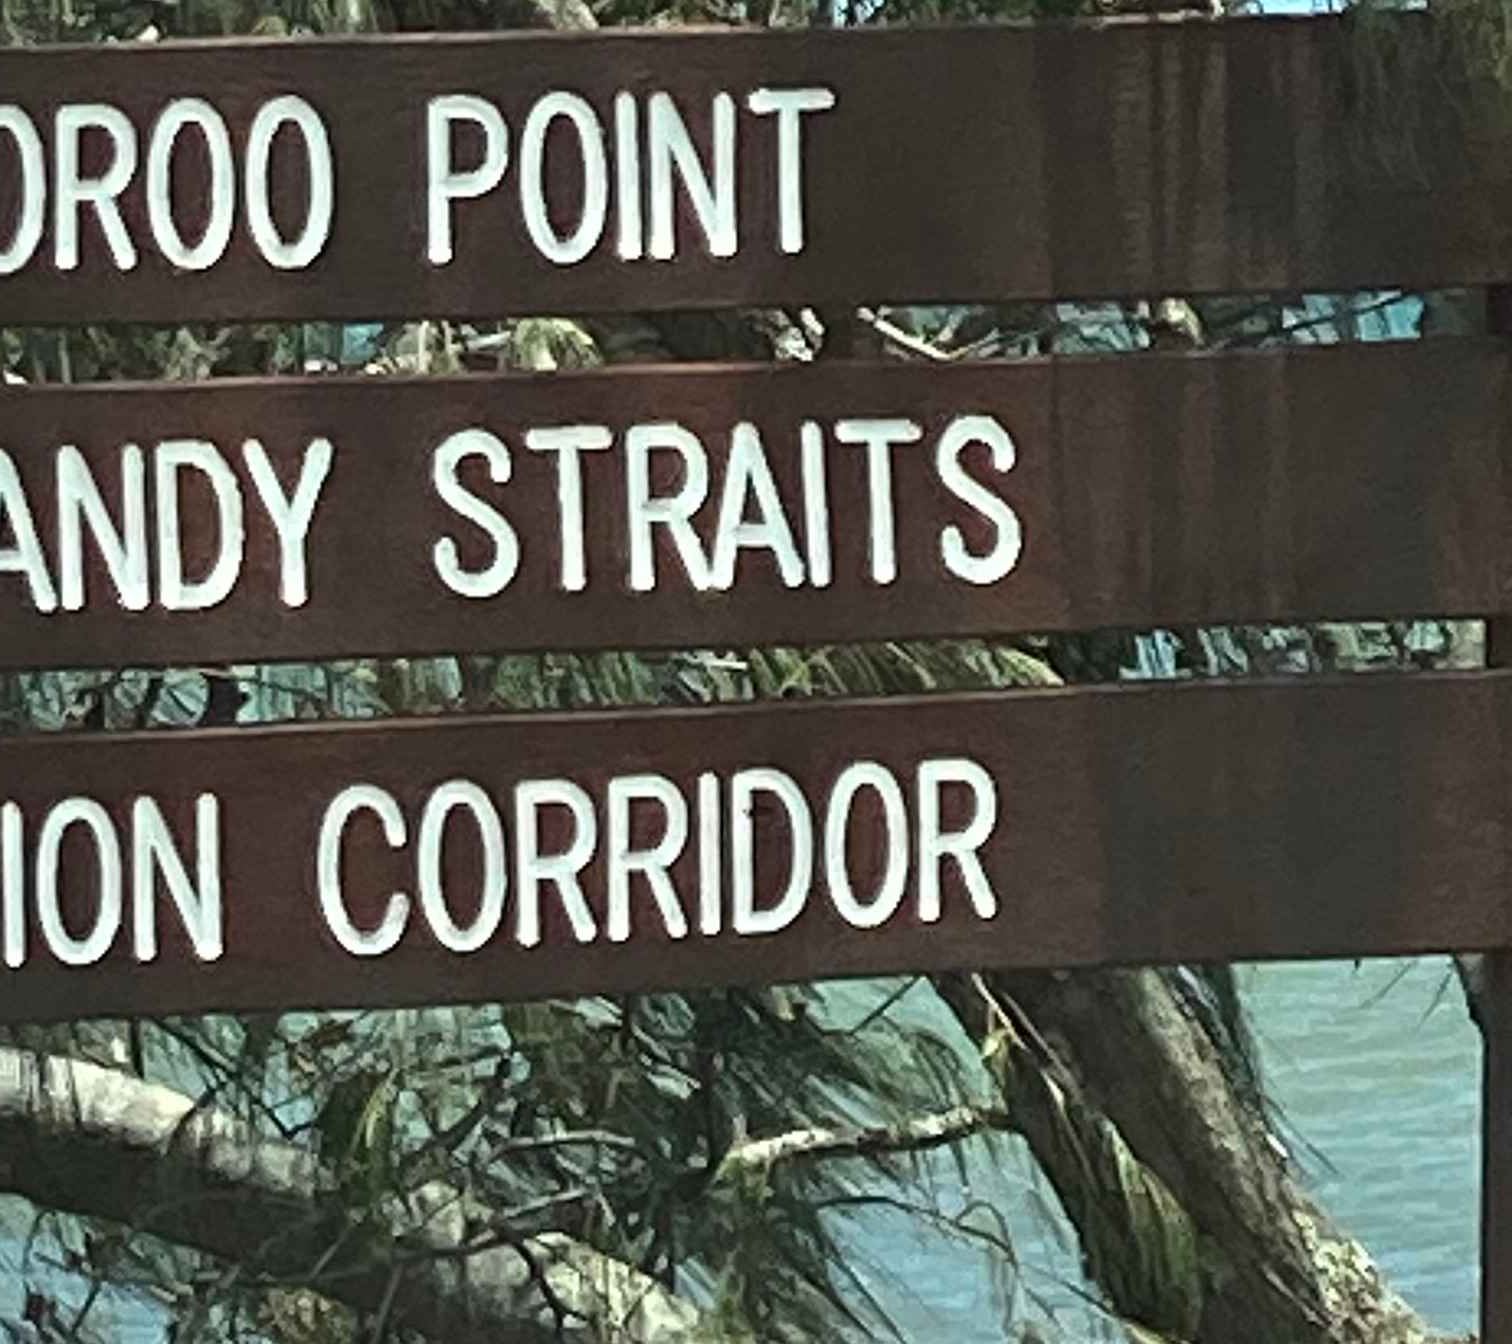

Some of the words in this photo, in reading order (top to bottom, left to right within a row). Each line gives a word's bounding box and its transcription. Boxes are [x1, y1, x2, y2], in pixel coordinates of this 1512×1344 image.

[427, 87, 836, 265] POINT
[432, 415, 1022, 598] STRAITS
[317, 759, 996, 956] CORRIDOR
